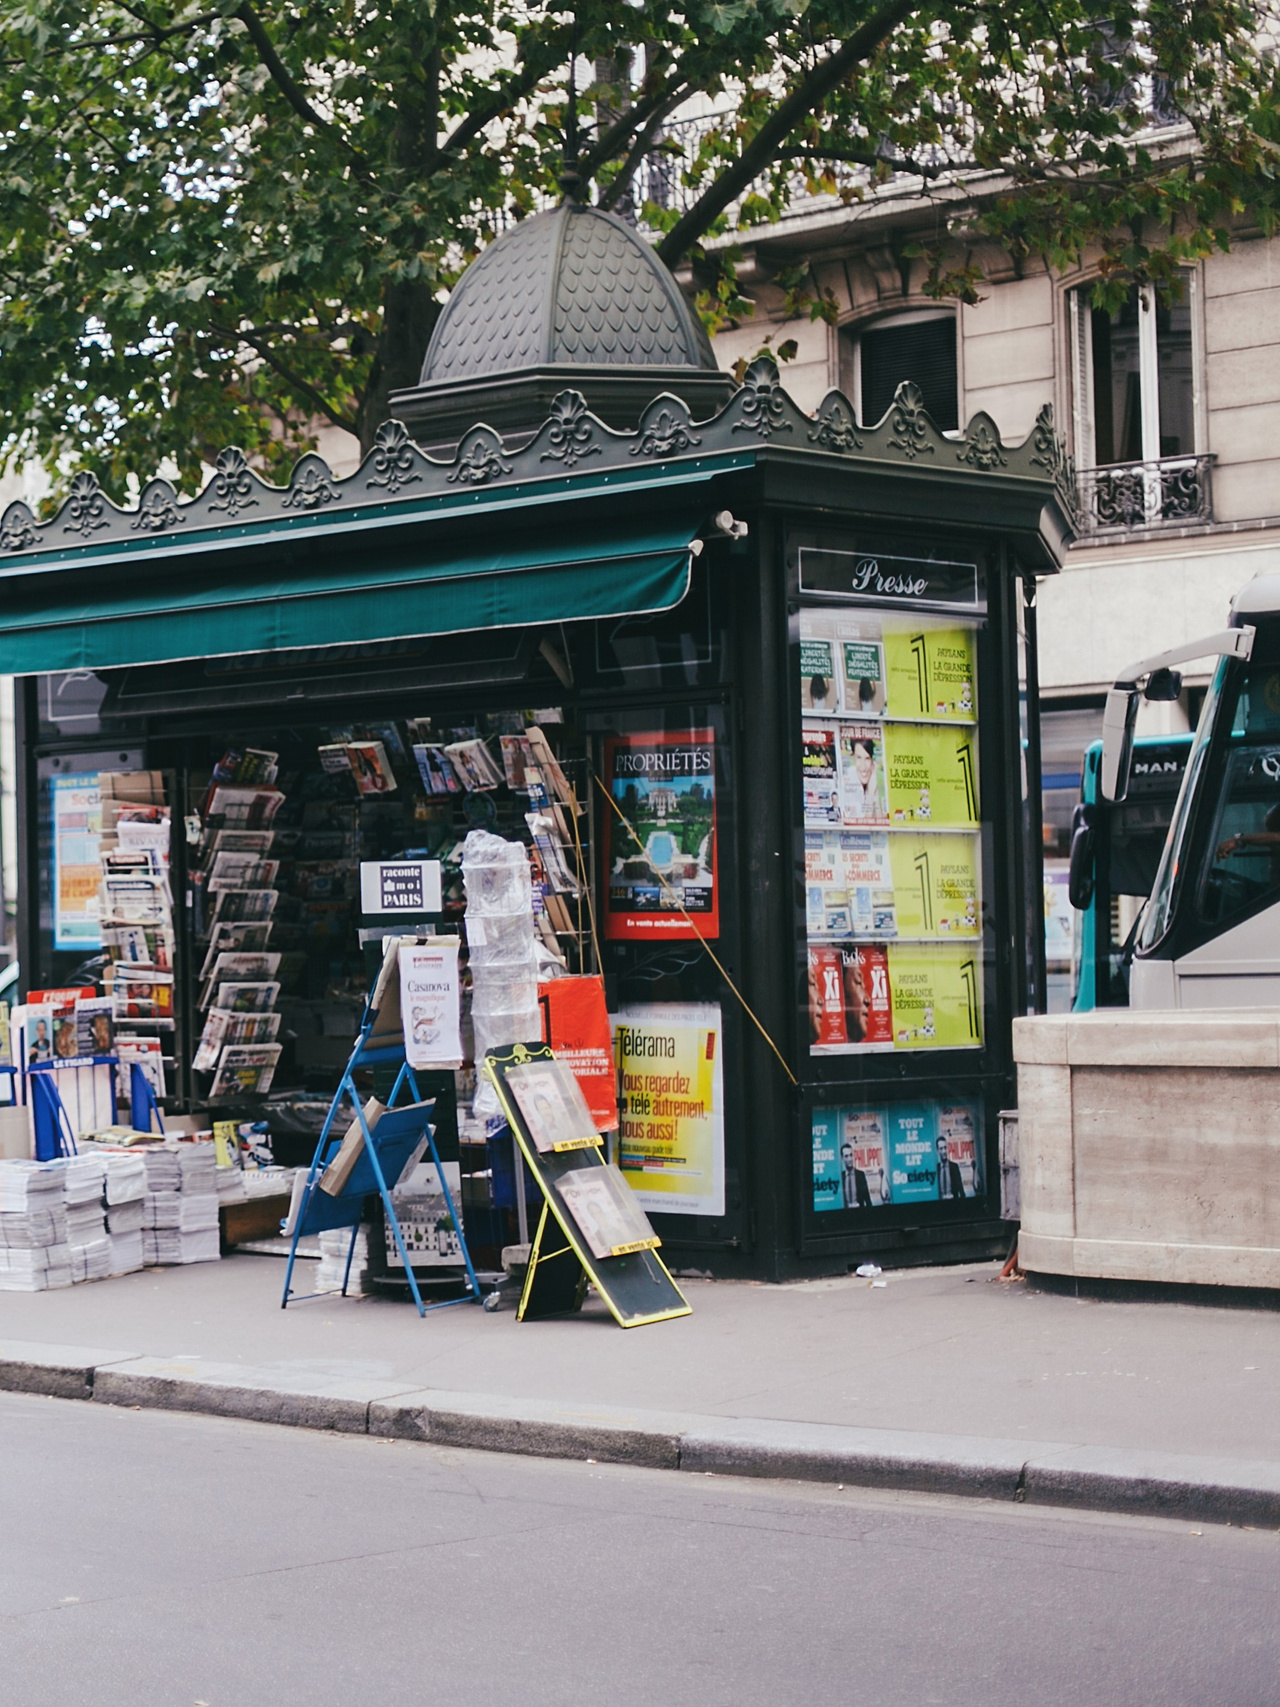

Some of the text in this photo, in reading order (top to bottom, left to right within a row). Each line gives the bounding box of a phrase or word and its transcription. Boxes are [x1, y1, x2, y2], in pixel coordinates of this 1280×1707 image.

[851, 557, 929, 596] Presse
[937, 647, 966, 659] PAYSANS
[800, 656, 831, 666] NÉGALITÉS
[933, 661, 971, 673] LA GRANDE
[910, 634, 929, 713] 1
[933, 672, 973, 684] DÉPRESSION
[615, 747, 711, 772] PROPRIÉTÉS
[893, 755, 924, 765] PAYSANS
[890, 768, 929, 779] LA GRANDE
[1134, 761, 1177, 774] MAN
[890, 779, 931, 790] DÉPRESSION
[956, 743, 978, 822] 1
[383, 867, 420, 878] raconte
[940, 864, 969, 874] PAYSANS
[936, 879, 975, 888] LA GRANDE
[913, 851, 934, 931] 1
[936, 888, 976, 899] DÉPRESSION
[383, 893, 422, 906] PARIS
[627, 919, 634, 927] En
[636, 919, 653, 927] vente
[822, 970, 841, 1000] Xi
[870, 969, 888, 999] Xi
[898, 974, 928, 984] PAYSANS
[407, 980, 450, 993] Casanova
[895, 988, 934, 998] LA GRANDE
[960, 959, 980, 1039] 1
[895, 998, 935, 1010] DÉPRESSION
[617, 1027, 676, 1059] Télérama
[53, 1057, 94, 1069] LE FIGARO
[569, 1058, 609, 1068] OVATION
[571, 1067, 609, 1076] TORIALE
[644, 1070, 691, 1098] regardez
[630, 1092, 651, 1115] télé
[652, 1097, 708, 1121] autrement,
[898, 1117, 924, 1129] TOUT
[619, 1120, 645, 1139] nous
[906, 1130, 919, 1141] LE
[570, 1140, 588, 1148] vente
[895, 1141, 932, 1154] MONDE
[813, 1149, 835, 1161] NDE
[906, 1154, 923, 1166] LIT
[892, 1169, 937, 1186] Society
[627, 1243, 645, 1252] vente
